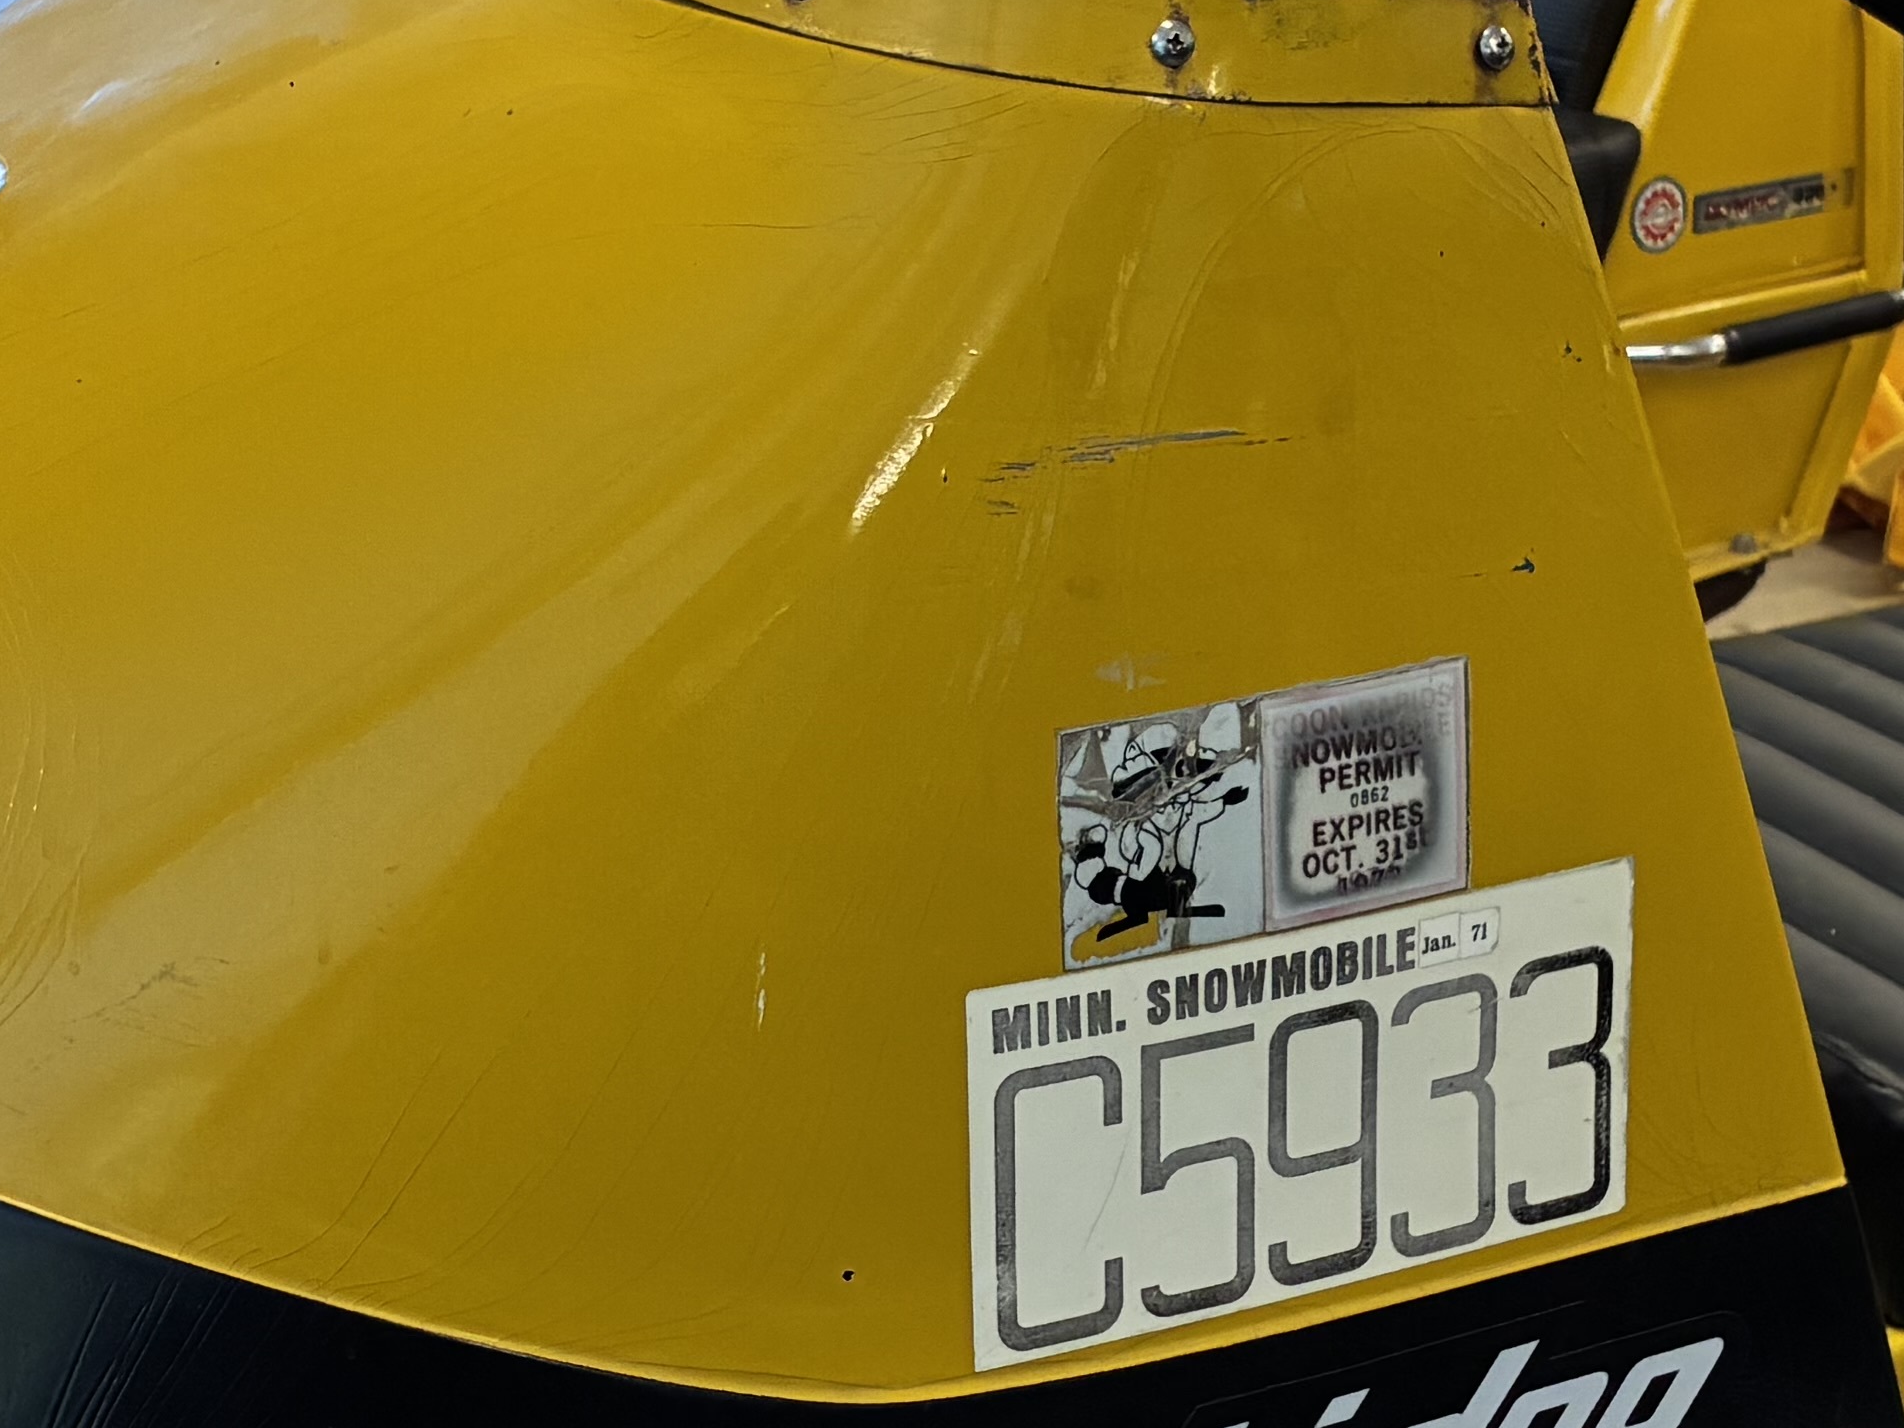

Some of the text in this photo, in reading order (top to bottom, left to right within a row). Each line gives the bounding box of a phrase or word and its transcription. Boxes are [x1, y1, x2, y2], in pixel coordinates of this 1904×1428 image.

[1318, 750, 1422, 794] PERMIT
[1312, 800, 1425, 848] EXPIRES
[1301, 844, 1366, 879] OCT.
[991, 923, 1489, 1055] MINN. SNOWMOBILE Jan. 71
[993, 944, 1614, 1352] C5933
